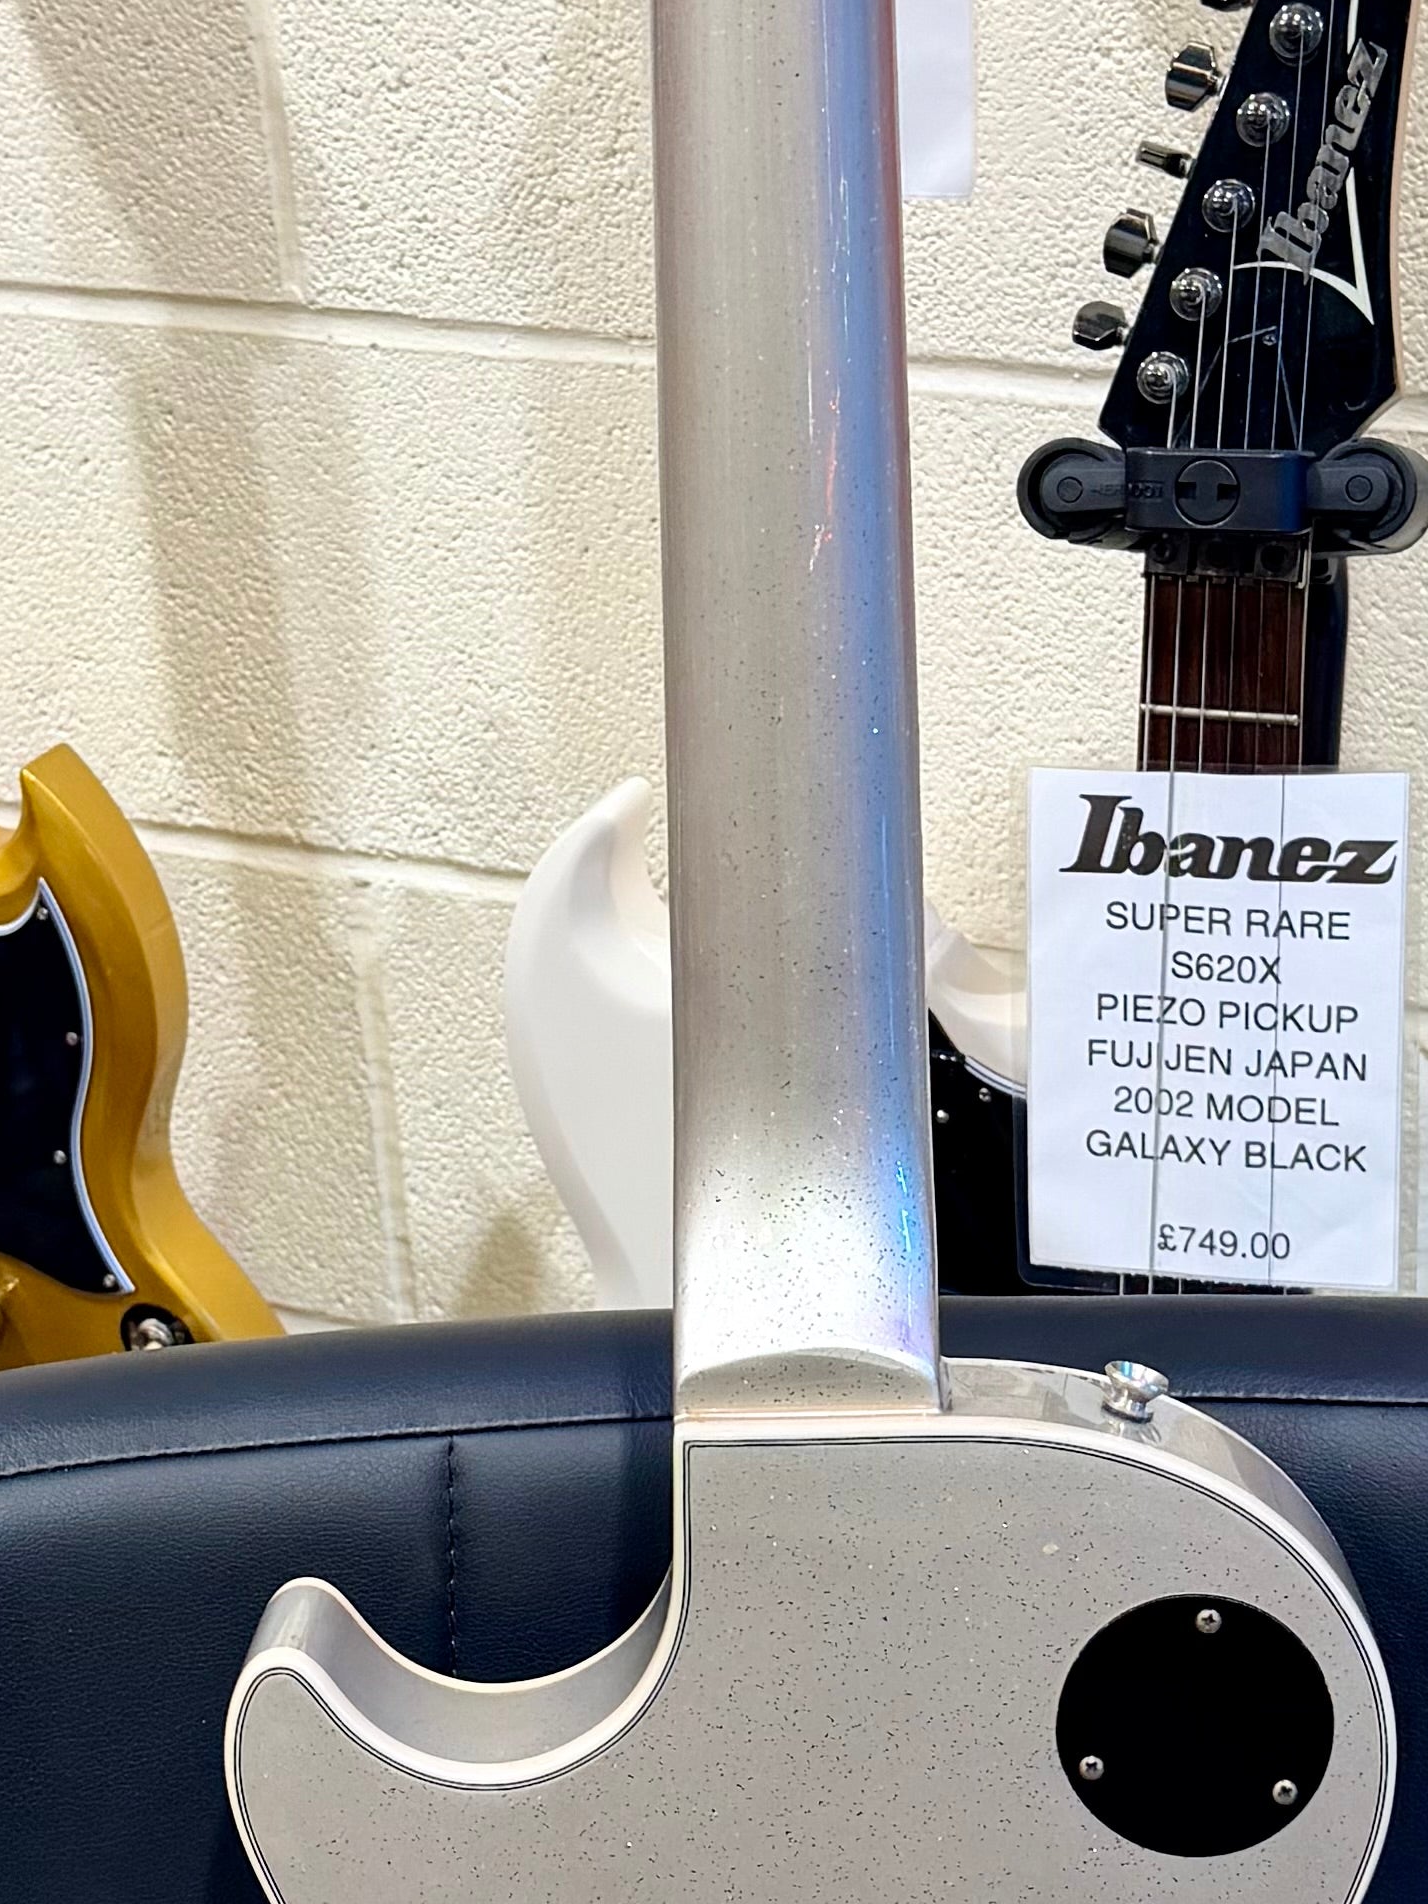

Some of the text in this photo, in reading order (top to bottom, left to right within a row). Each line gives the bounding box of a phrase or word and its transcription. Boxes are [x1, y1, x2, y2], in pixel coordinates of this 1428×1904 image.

[1256, 37, 1389, 286] Ibanez
[1059, 793, 1398, 884] Ibanez
[1106, 901, 1351, 940] SUPER RARE
[1171, 951, 1282, 984] S620X
[1097, 993, 1358, 1034] PIEZO PICKUP
[1245, 1049, 1367, 1081] JAPAN
[1113, 1086, 1340, 1126] 2002 MODEL
[1086, 1129, 1367, 1172] GALAXY BLACK
[1157, 1223, 1290, 1259] £749.00
